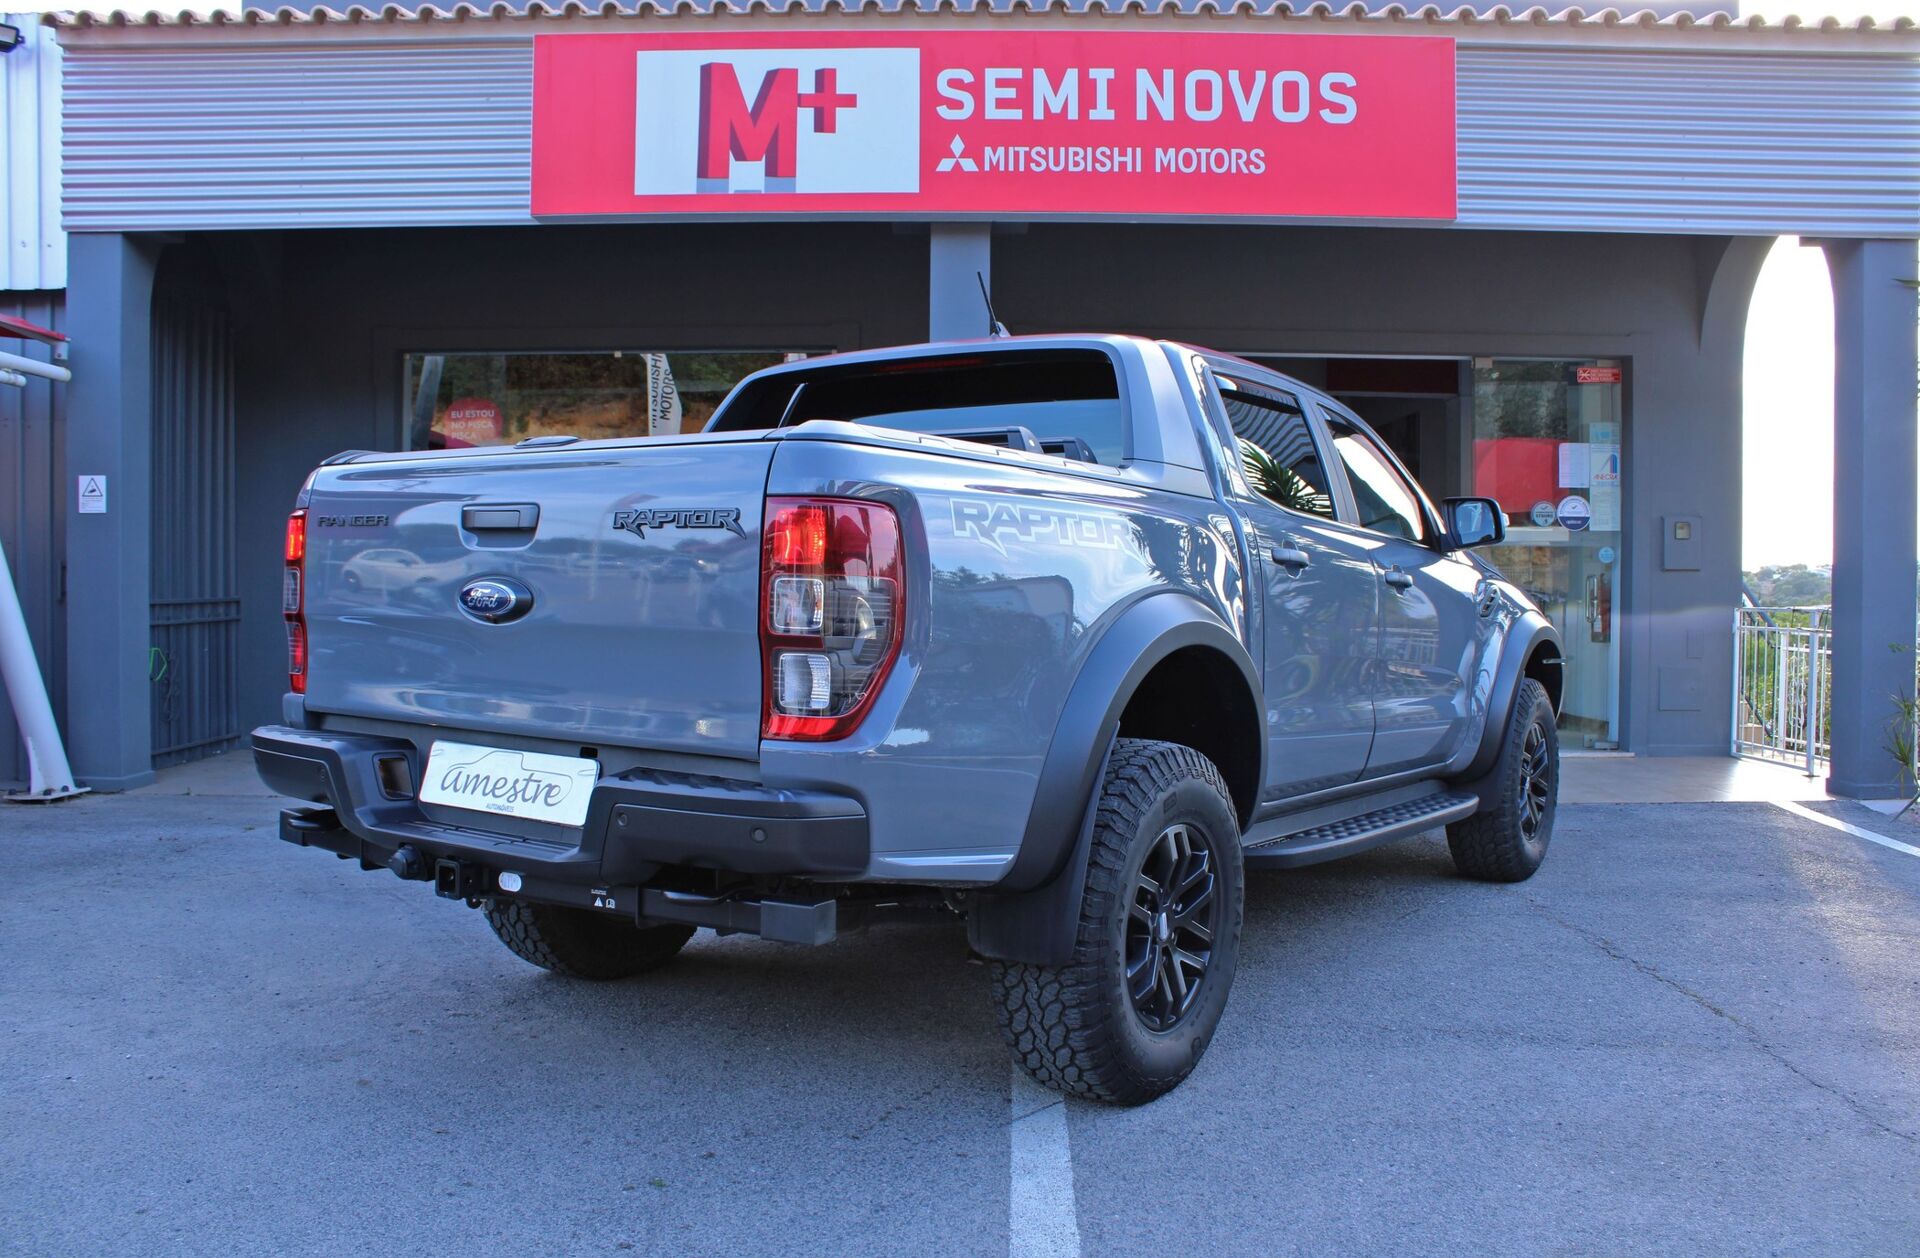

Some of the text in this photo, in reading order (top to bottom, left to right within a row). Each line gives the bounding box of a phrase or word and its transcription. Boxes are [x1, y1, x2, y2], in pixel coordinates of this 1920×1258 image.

[936, 68, 1358, 124] SEMI NOVOS
[984, 146, 1266, 175] MITSUBISHI MOTORS
[451, 409, 495, 418] EU ESTOU
[318, 515, 389, 527] RANGER
[613, 507, 747, 540] RAPTOR
[950, 498, 1153, 570] RAPTOR
[466, 587, 500, 608] Ford
[440, 767, 561, 806] amestre
